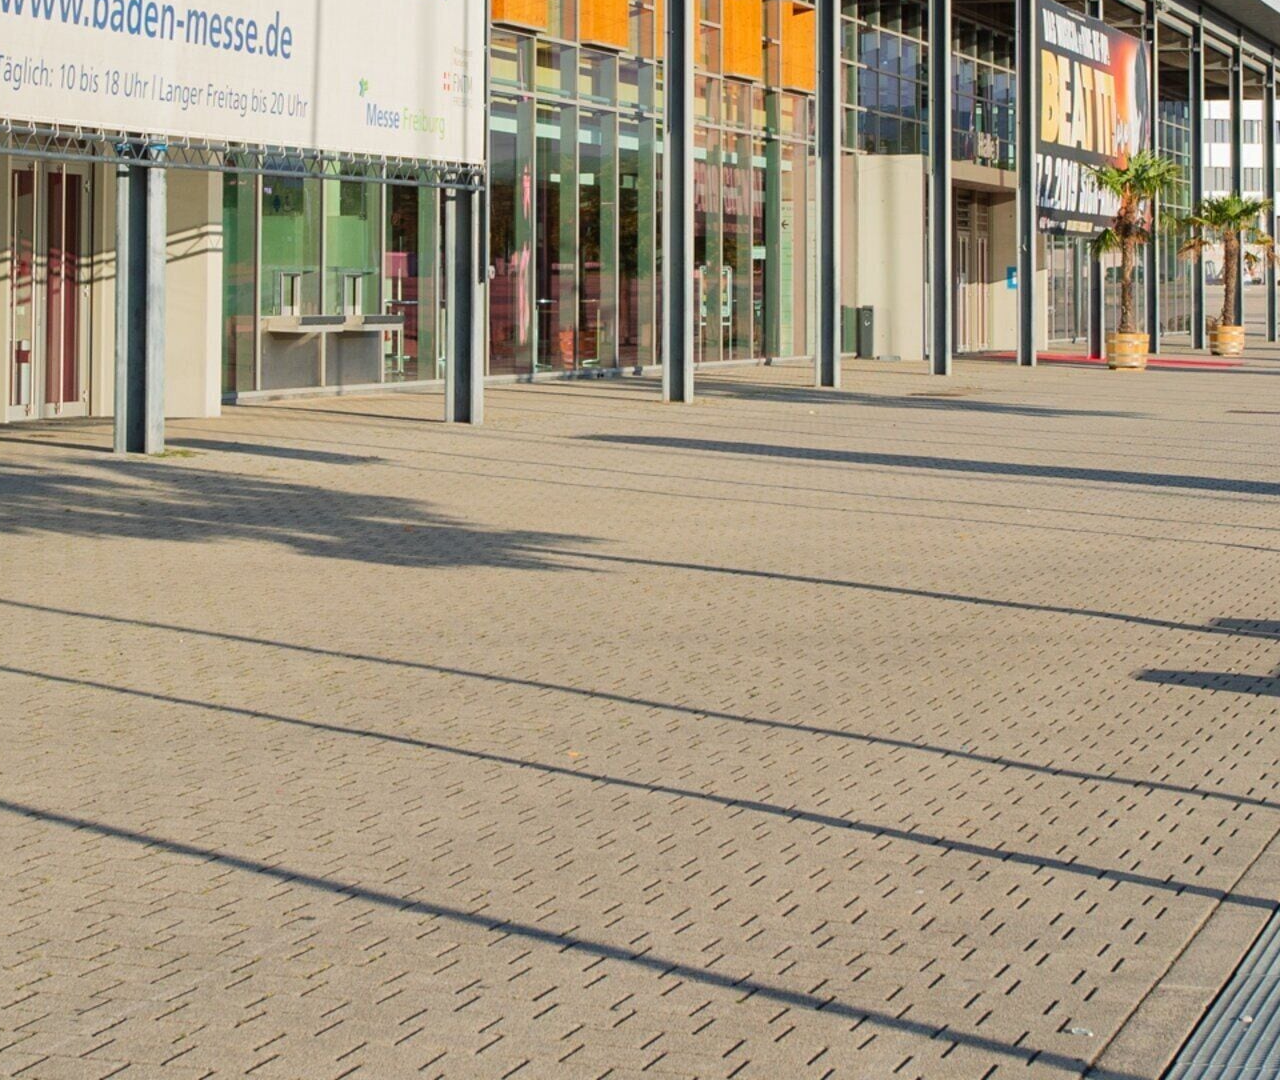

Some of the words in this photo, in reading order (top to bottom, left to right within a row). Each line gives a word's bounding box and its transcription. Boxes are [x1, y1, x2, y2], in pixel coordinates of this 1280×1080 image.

[60, 64, 76, 90] 10
[80, 67, 99, 93] bis
[104, 70, 120, 97] 18
[124, 73, 148, 100] Uhr
[159, 77, 203, 111] Langer
[207, 84, 248, 118] Freitag
[251, 90, 268, 114] bis
[270, 92, 284, 115] 20
[287, 93, 309, 119] Uhr
[366, 102, 400, 129] Messe
[402, 107, 445, 140] Freiburg
